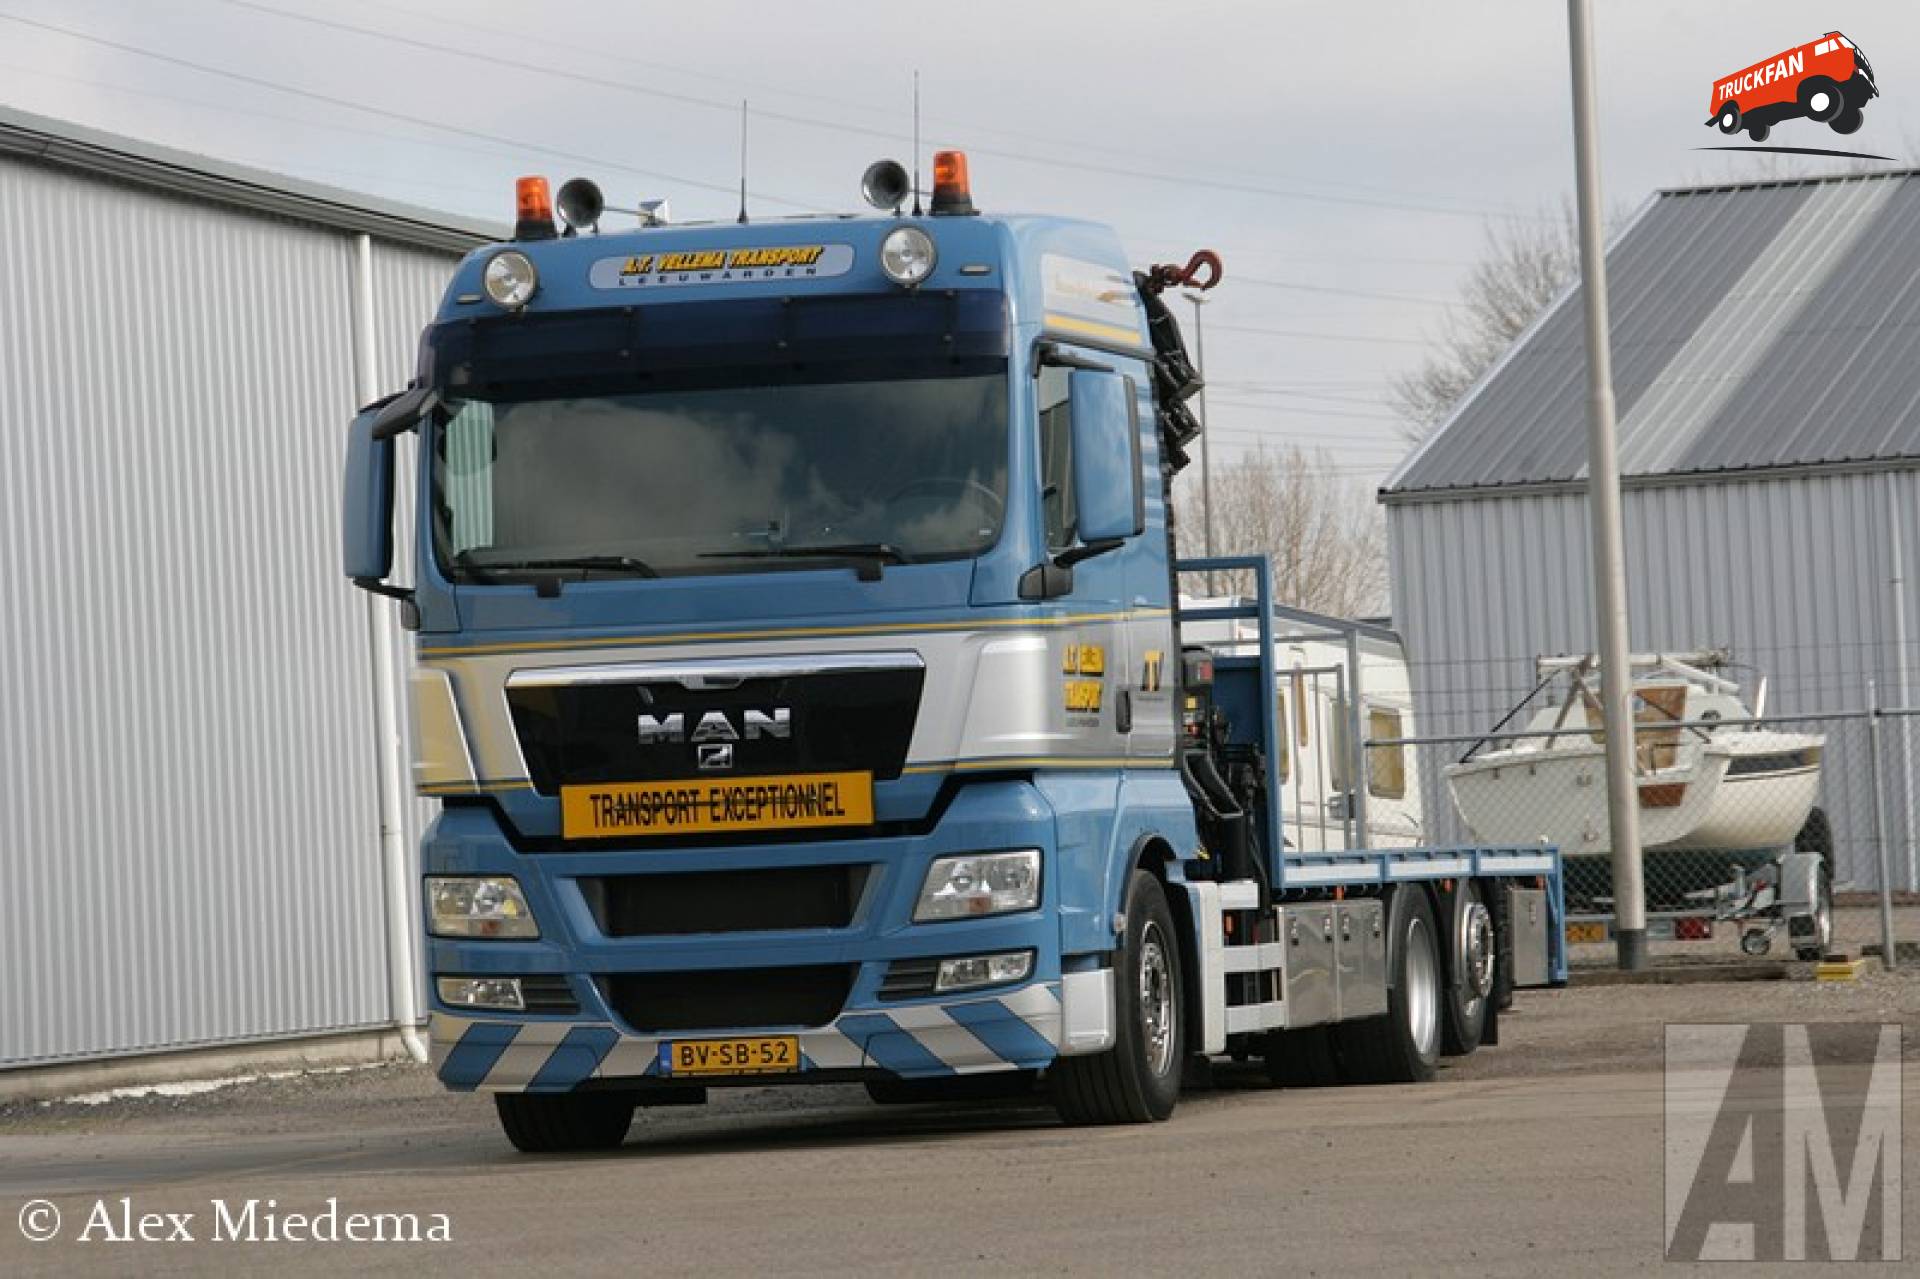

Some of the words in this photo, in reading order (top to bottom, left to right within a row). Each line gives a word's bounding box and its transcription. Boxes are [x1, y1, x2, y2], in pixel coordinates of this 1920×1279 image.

[727, 246, 824, 268] TRANSPORT
[618, 266, 817, 286] LEEUWARDEN
[637, 707, 791, 744] MAN
[590, 788, 700, 828] TRANSPORT
[710, 781, 845, 822] EXCEPTIONNEL
[681, 1041, 791, 1066] BV-SB-52
